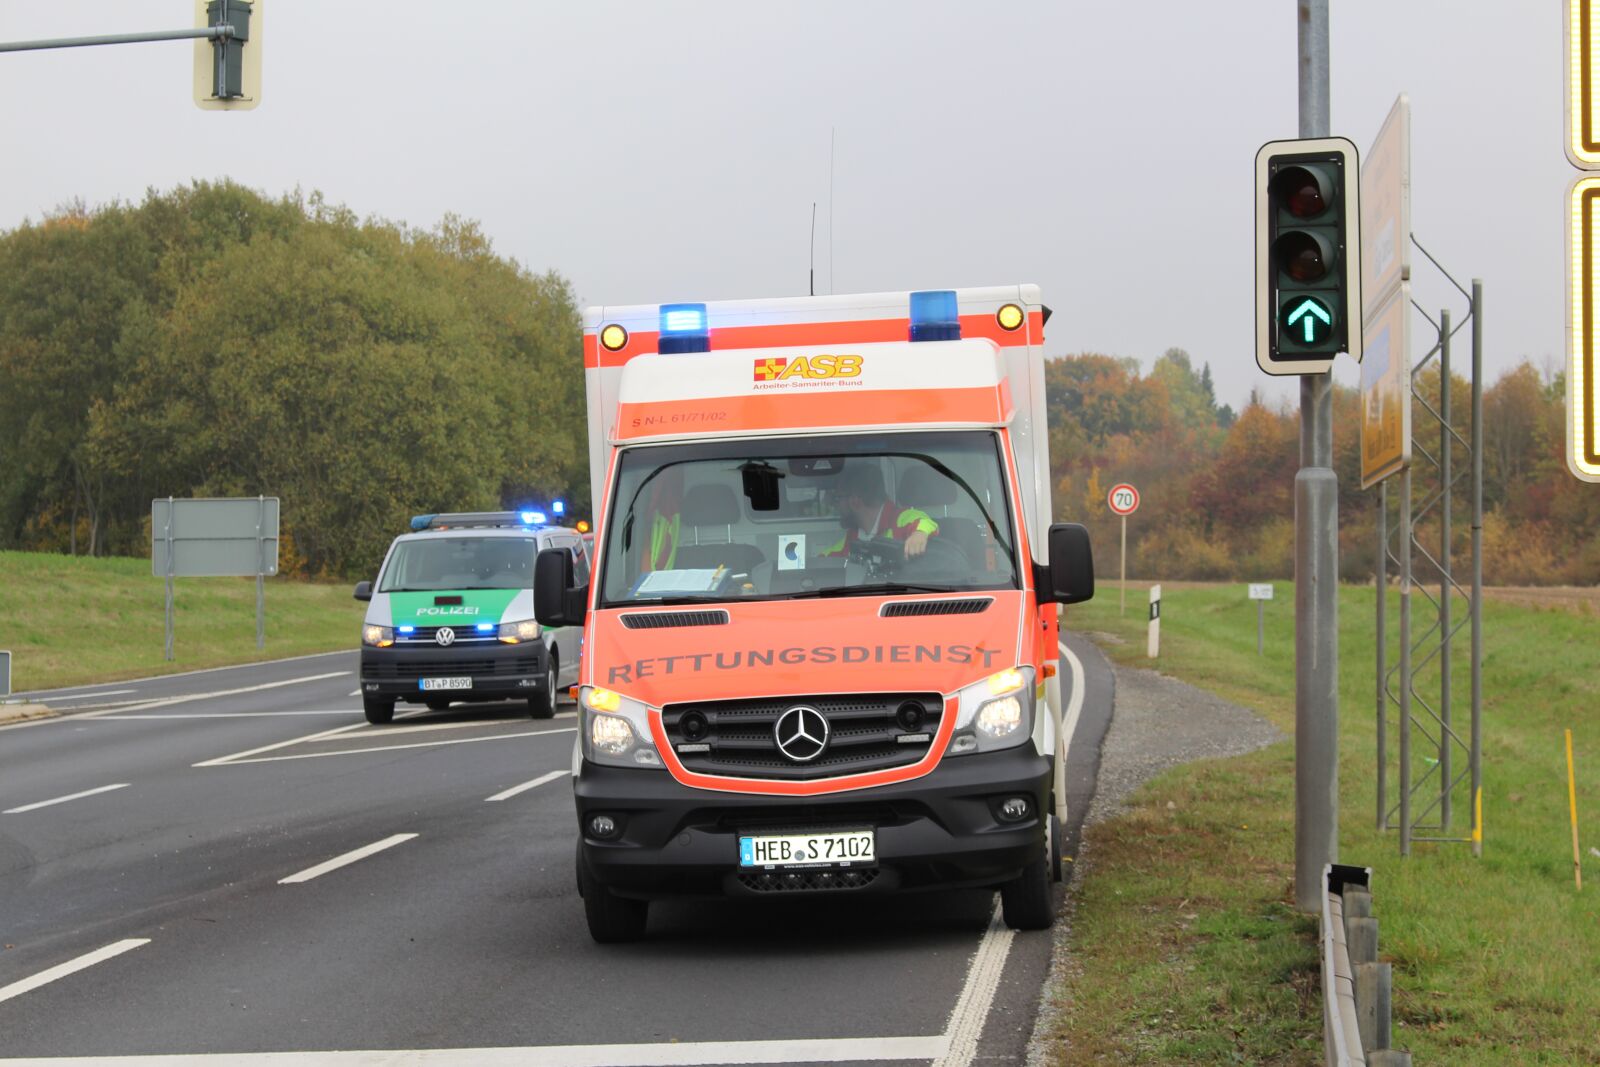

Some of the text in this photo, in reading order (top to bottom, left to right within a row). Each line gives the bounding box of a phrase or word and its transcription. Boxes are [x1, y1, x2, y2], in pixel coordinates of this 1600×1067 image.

[777, 354, 864, 380] ASB
[753, 380, 863, 390] Arbeiter-Samariter-Bund
[1116, 492, 1132, 506] 70
[416, 606, 480, 616] POLIZEI
[607, 645, 1002, 685] RETTUNGSDIENST
[425, 680, 436, 688] BT
[755, 837, 872, 861] HEB S 7102
